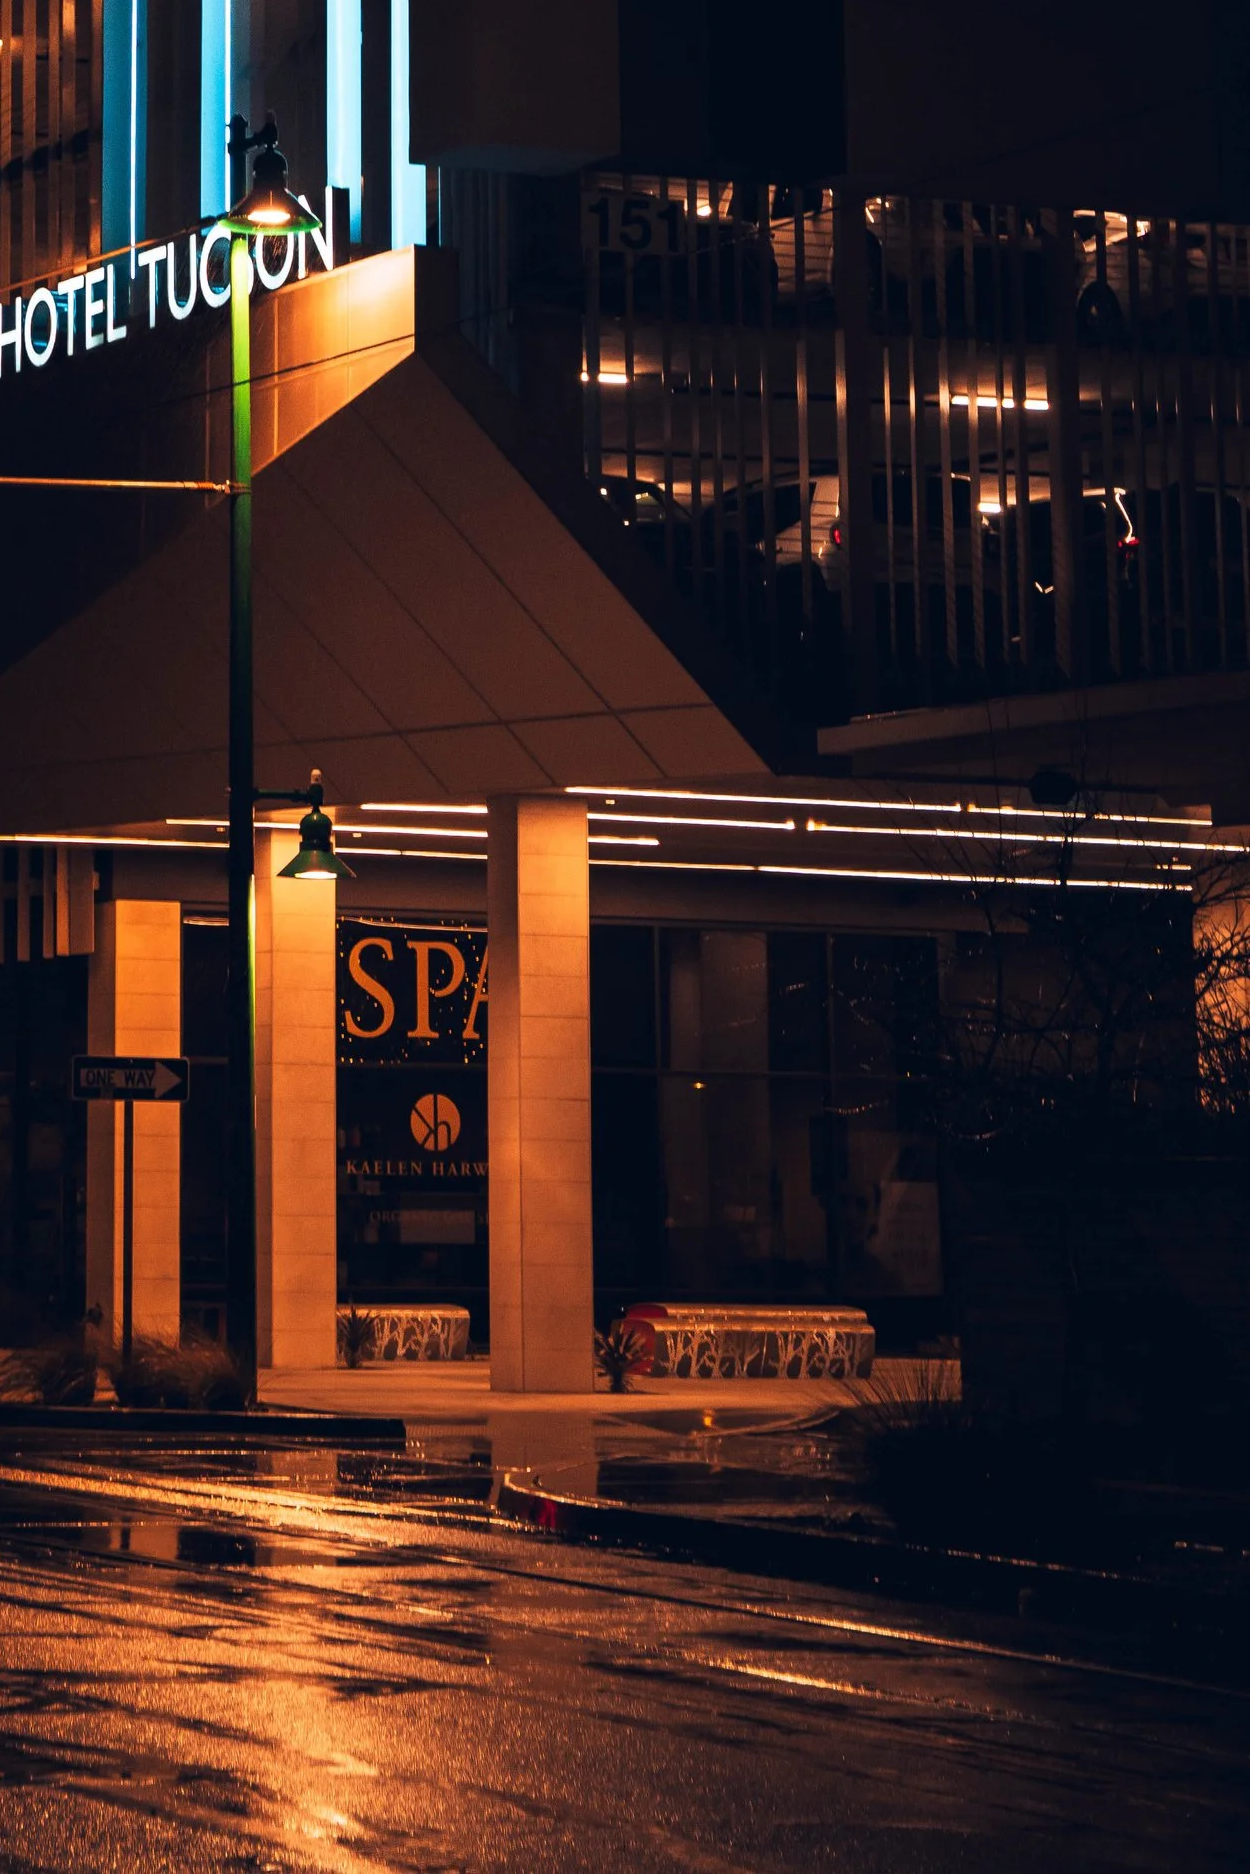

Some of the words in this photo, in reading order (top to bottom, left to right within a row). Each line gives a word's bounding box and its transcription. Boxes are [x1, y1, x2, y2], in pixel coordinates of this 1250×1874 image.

[588, 196, 680, 254] 151
[138, 185, 334, 331] TUCON
[86, 1069, 116, 1086] ONE
[124, 1070, 155, 1087] WAY
[346, 1158, 422, 1175] KAELEN
